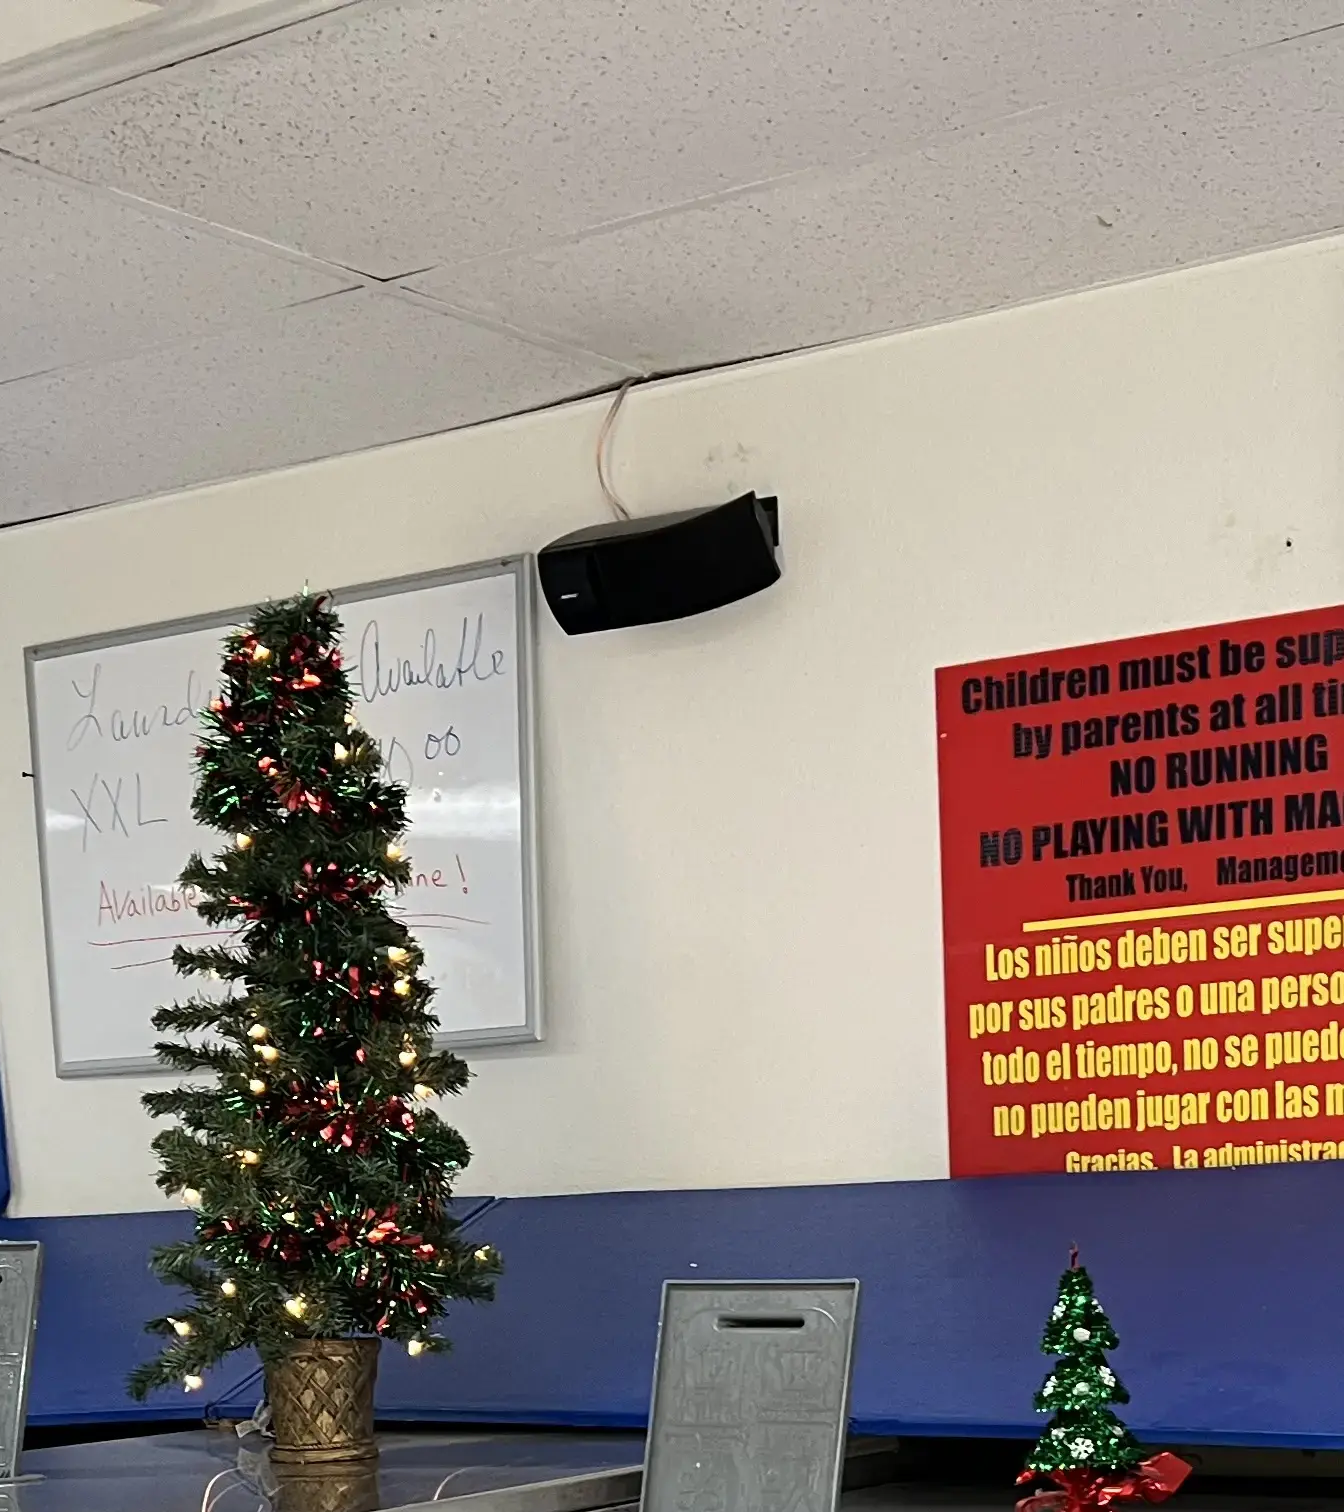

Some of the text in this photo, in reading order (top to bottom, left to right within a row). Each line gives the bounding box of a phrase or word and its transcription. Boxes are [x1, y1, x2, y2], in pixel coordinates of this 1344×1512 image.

[356, 612, 510, 704] Available
[960, 661, 1111, 715] Children
[1118, 645, 1212, 695] must
[1219, 637, 1267, 678] be
[1012, 722, 1054, 761] by
[1061, 704, 1202, 757] parents
[1208, 694, 1247, 732] at
[1254, 683, 1304, 726] all
[1108, 733, 1331, 799] NO RUNNING
[68, 770, 170, 854] XXL
[978, 827, 1024, 869] NO
[1031, 810, 1170, 864] PLAYING
[1177, 797, 1275, 848] WITH
[1065, 868, 1137, 903] Thank
[1140, 863, 1190, 900] You,
[985, 940, 1031, 984] Los
[1034, 932, 1113, 978] niños
[1117, 926, 1209, 972] deben
[1212, 921, 1262, 961] ser
[968, 1001, 1014, 1041] por
[1018, 994, 1069, 1033] sus
[1071, 984, 1172, 1031] padres
[1175, 982, 1195, 1019] o
[1199, 977, 1254, 1018] una
[982, 1043, 1041, 1087] todo
[1045, 1038, 1073, 1082] el
[1076, 1034, 1179, 1081] tiempo,
[1182, 1035, 1219, 1072] no
[1223, 1031, 1260, 1069] se
[992, 1103, 1027, 1138] no
[1030, 1092, 1133, 1140] pueden
[1135, 1087, 1211, 1133] jugar
[1215, 1083, 1271, 1124] con
[1274, 1076, 1321, 1119] las
[1172, 1145, 1200, 1170] La
